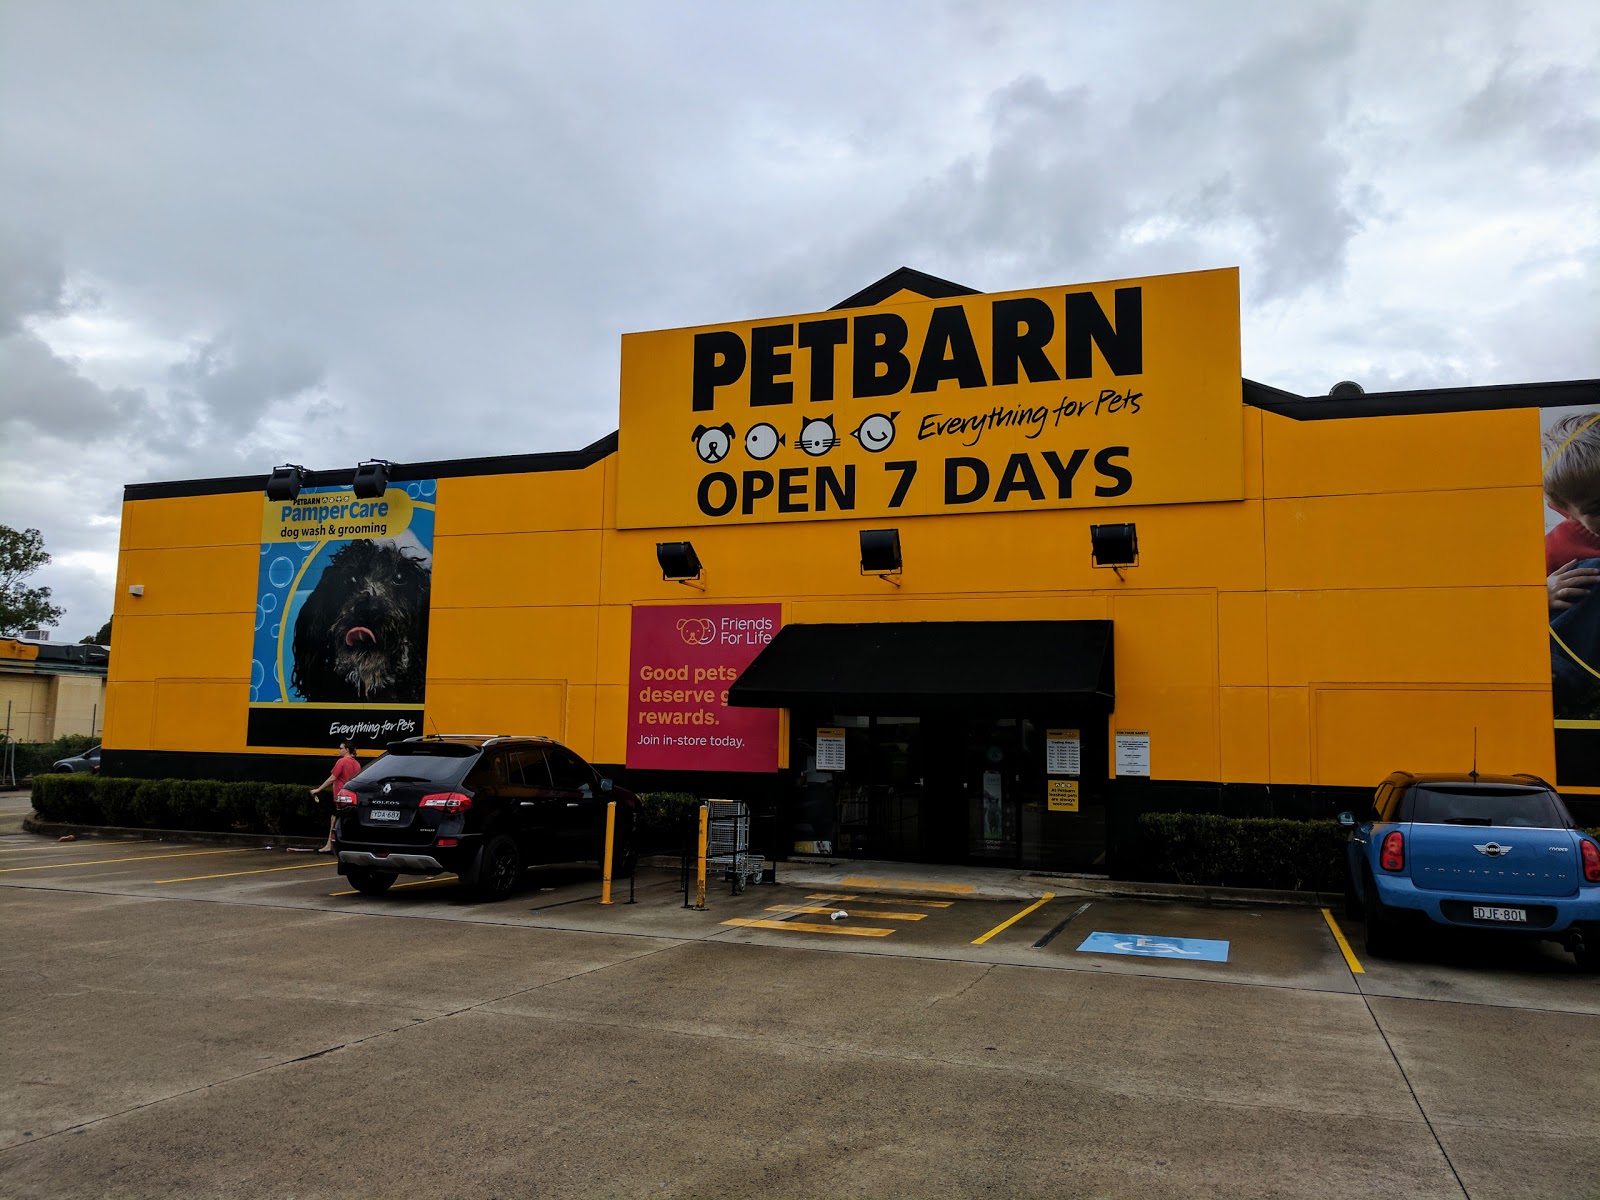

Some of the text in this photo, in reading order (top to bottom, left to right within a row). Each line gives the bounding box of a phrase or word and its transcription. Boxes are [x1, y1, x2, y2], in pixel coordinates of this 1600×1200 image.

[692, 287, 1143, 411] PETBARN
[917, 388, 1144, 446] Everything for Pets
[697, 446, 1134, 517] OPEN 7 DAYS
[293, 498, 321, 506] PETBARN
[280, 522, 387, 540] dog wash & grooming
[720, 617, 773, 631] Friends
[720, 630, 773, 645] For Life
[640, 664, 737, 684] Good pets
[639, 687, 715, 703] deserve
[638, 708, 720, 726] rewards.
[329, 718, 416, 740] Everything for Pets
[637, 734, 745, 749] Join in-store today.
